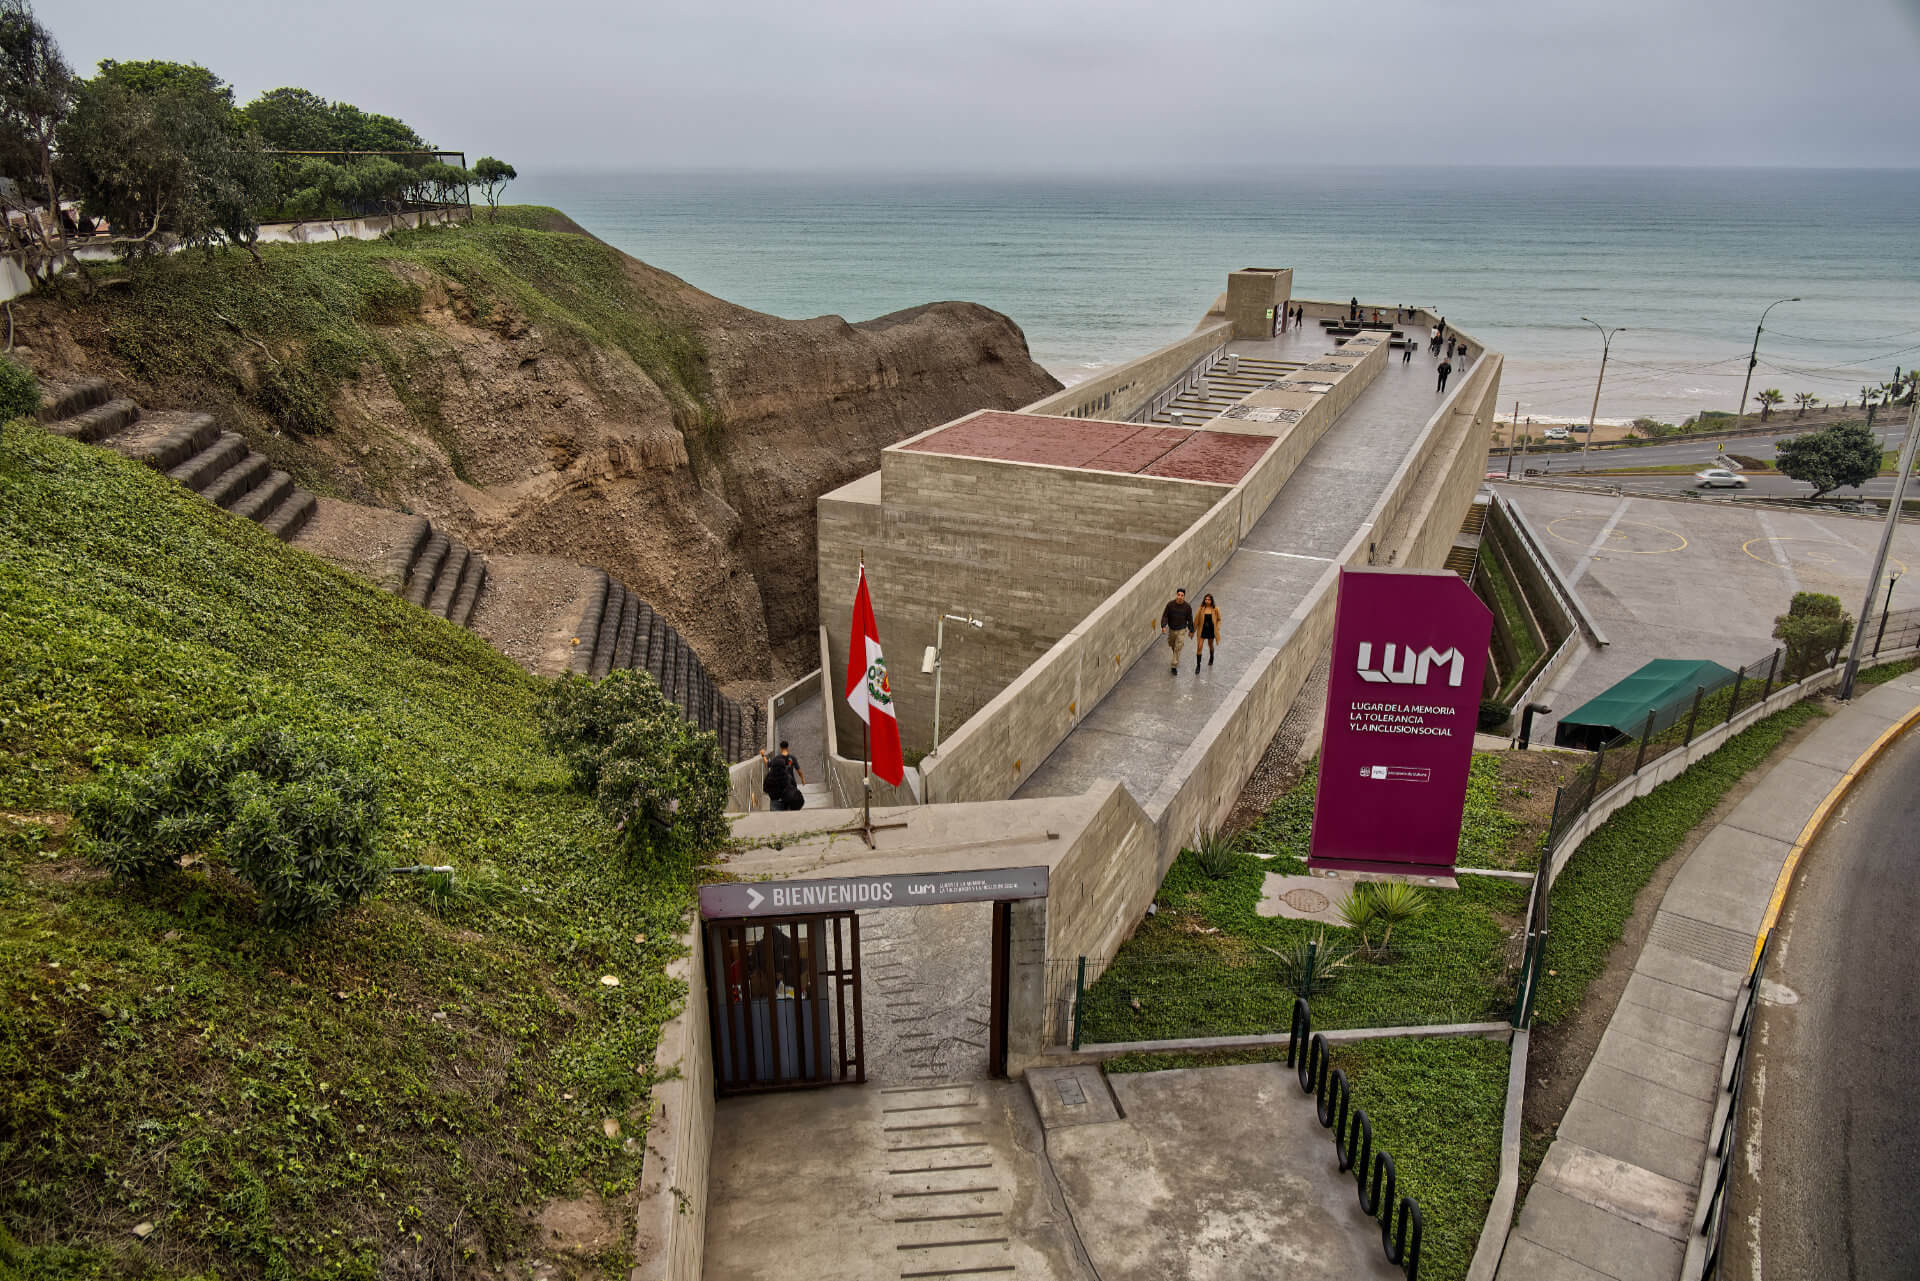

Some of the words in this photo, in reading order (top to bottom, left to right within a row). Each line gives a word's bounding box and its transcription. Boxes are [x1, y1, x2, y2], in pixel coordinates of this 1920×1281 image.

[1357, 641, 1464, 686] LUM
[1351, 702, 1383, 711] LUGAR
[1385, 703, 1397, 712] DE
[1398, 704, 1410, 713] LA
[1411, 705, 1456, 715] MEMORIA
[1350, 711, 1362, 721] LA
[1364, 713, 1424, 724] TOLERANCIA
[1350, 722, 1356, 731] Y
[1356, 722, 1368, 732] LA
[1419, 726, 1453, 737] SOCIAL
[773, 882, 893, 907] BIENVENIDOS
